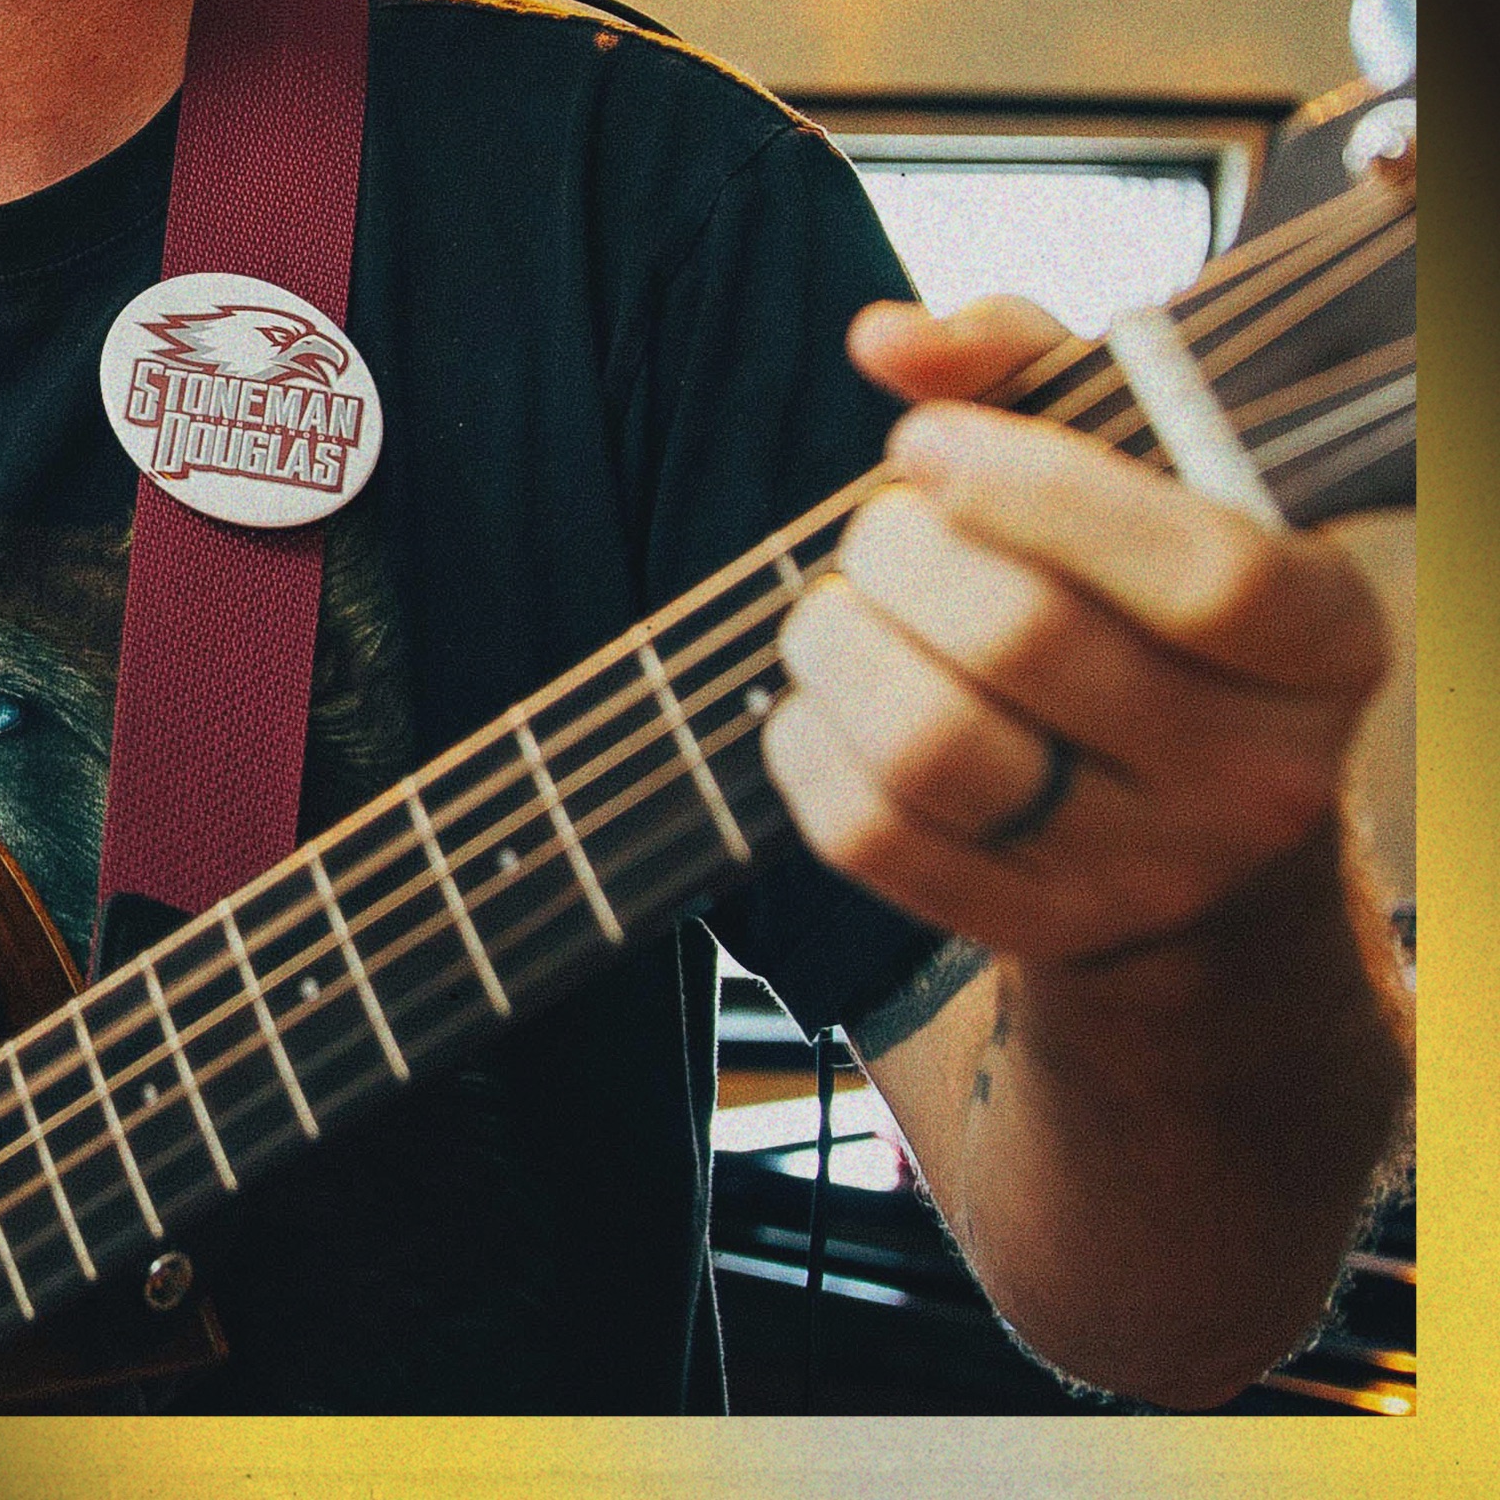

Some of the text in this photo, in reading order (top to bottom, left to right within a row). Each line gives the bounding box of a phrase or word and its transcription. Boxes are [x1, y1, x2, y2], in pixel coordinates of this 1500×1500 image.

[128, 360, 360, 440] STONEMAN
[195, 414, 339, 445] HIGH SCHOOL
[154, 410, 343, 487] DOUGLAS
